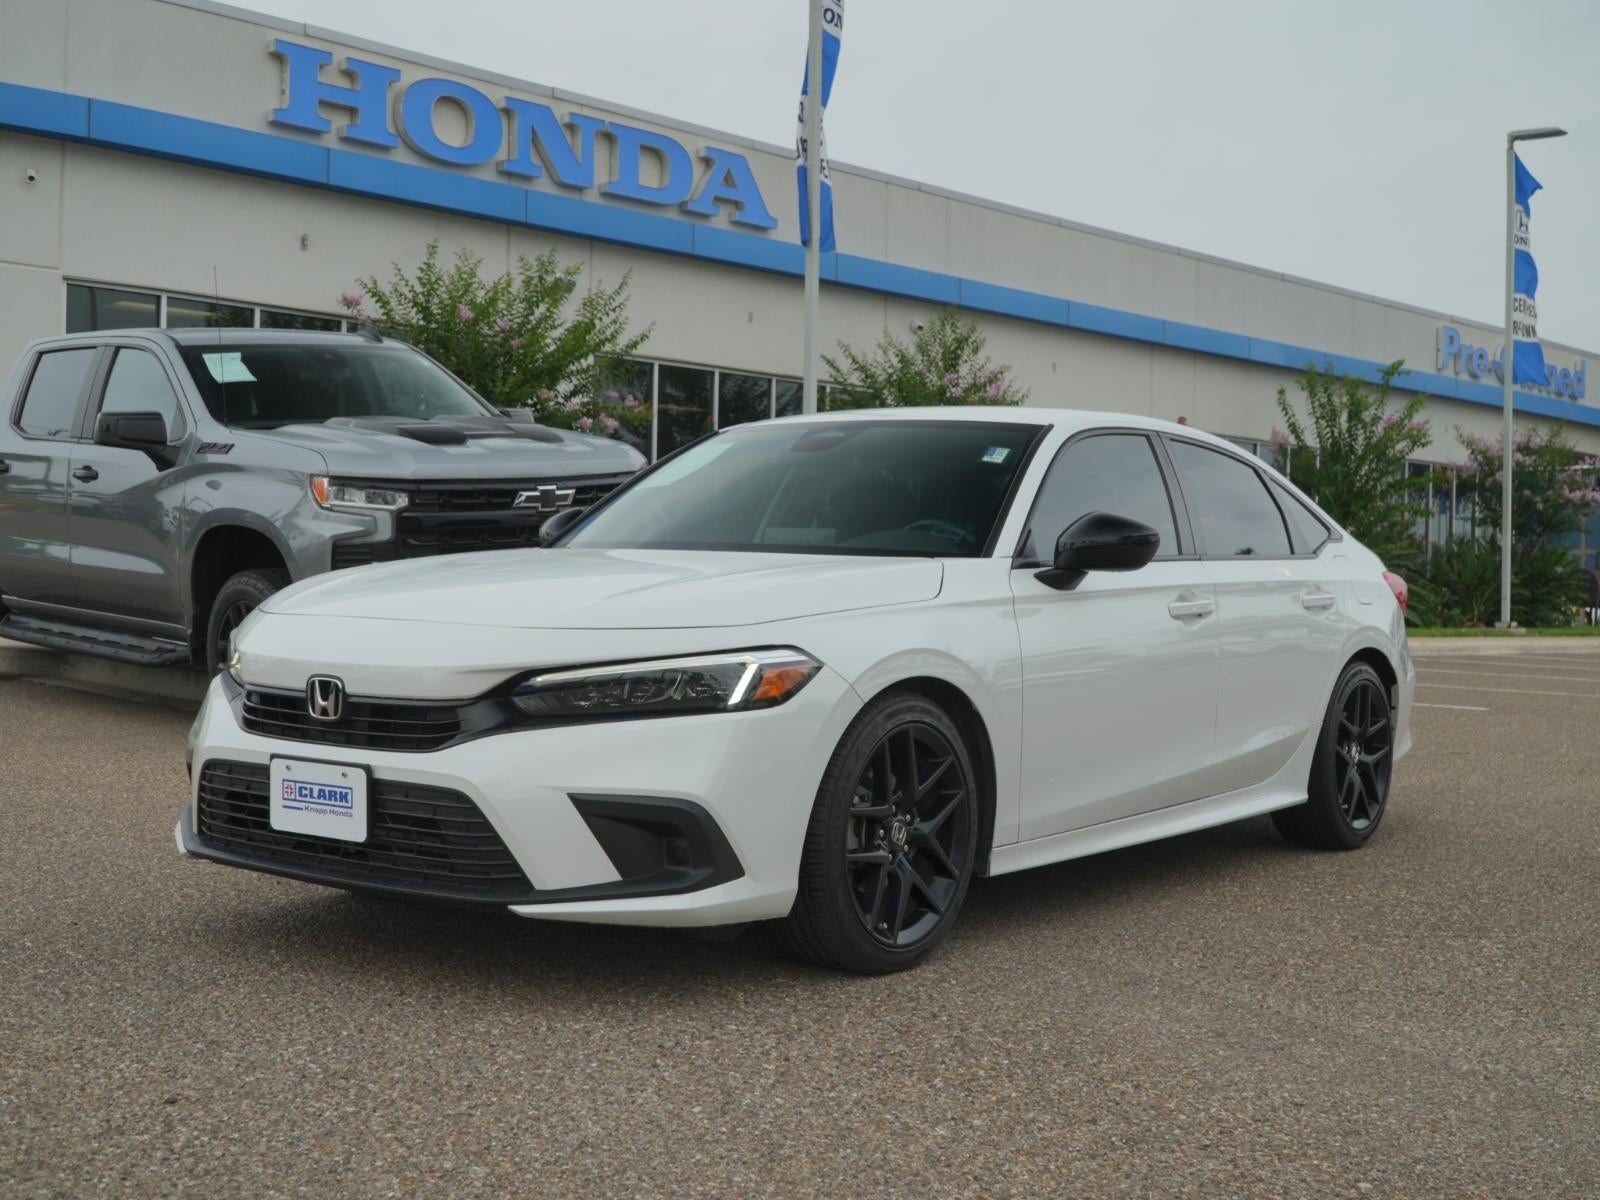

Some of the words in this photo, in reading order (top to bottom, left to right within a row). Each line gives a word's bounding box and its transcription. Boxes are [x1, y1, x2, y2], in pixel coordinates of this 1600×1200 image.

[268, 38, 778, 231] HONDA
[1438, 326, 1586, 400] Pre-ned
[298, 785, 350, 804] CLARK
[304, 804, 328, 816] Knapp
[329, 809, 353, 818] Honda
